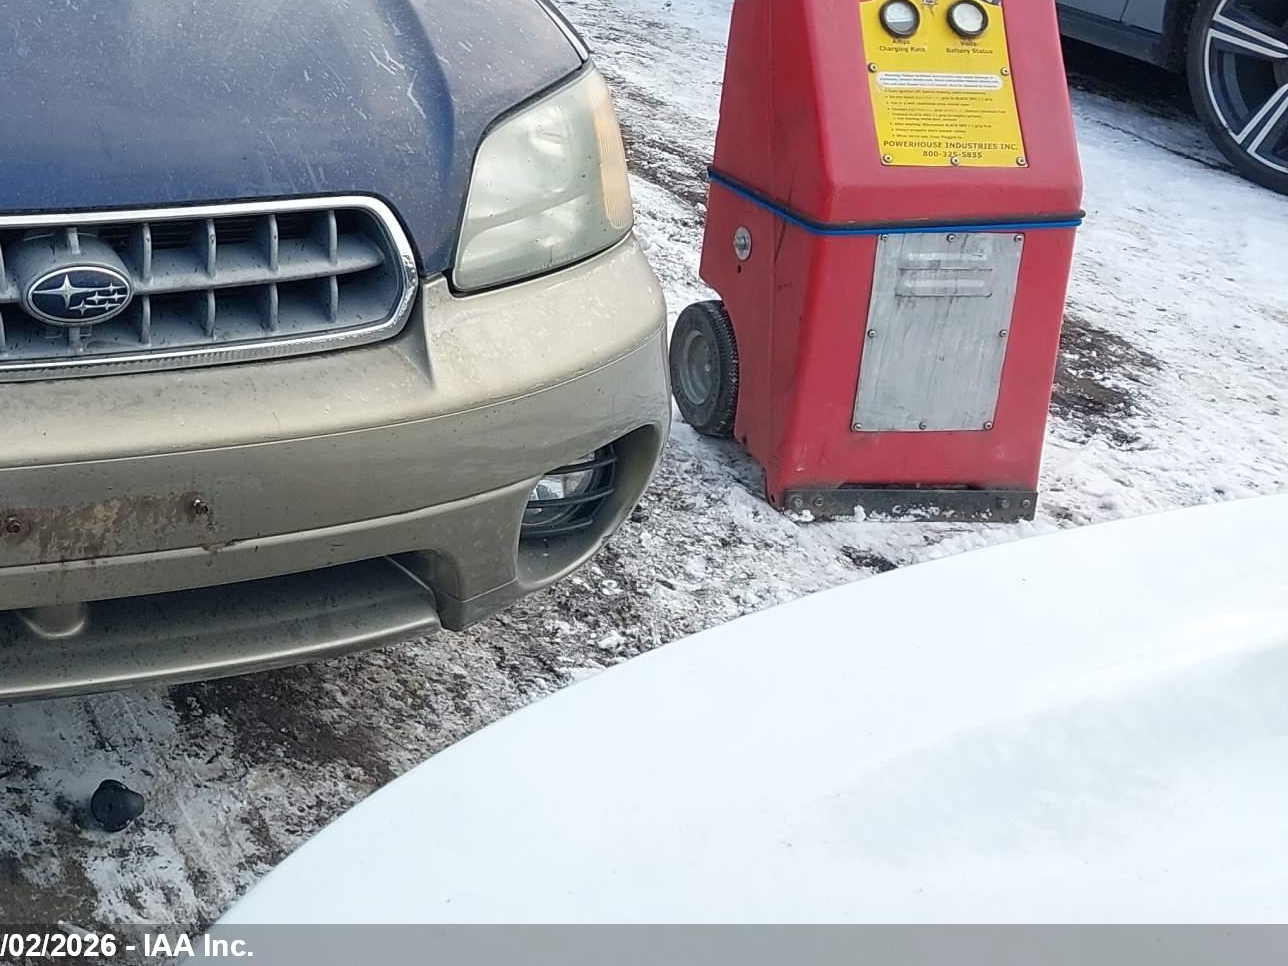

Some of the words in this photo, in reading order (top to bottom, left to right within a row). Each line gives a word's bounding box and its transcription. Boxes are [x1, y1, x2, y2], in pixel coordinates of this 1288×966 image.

[883, 140, 943, 149] POWERHOUSE
[945, 141, 999, 150] INDUSTRIES
[1000, 143, 1019, 151] INC.
